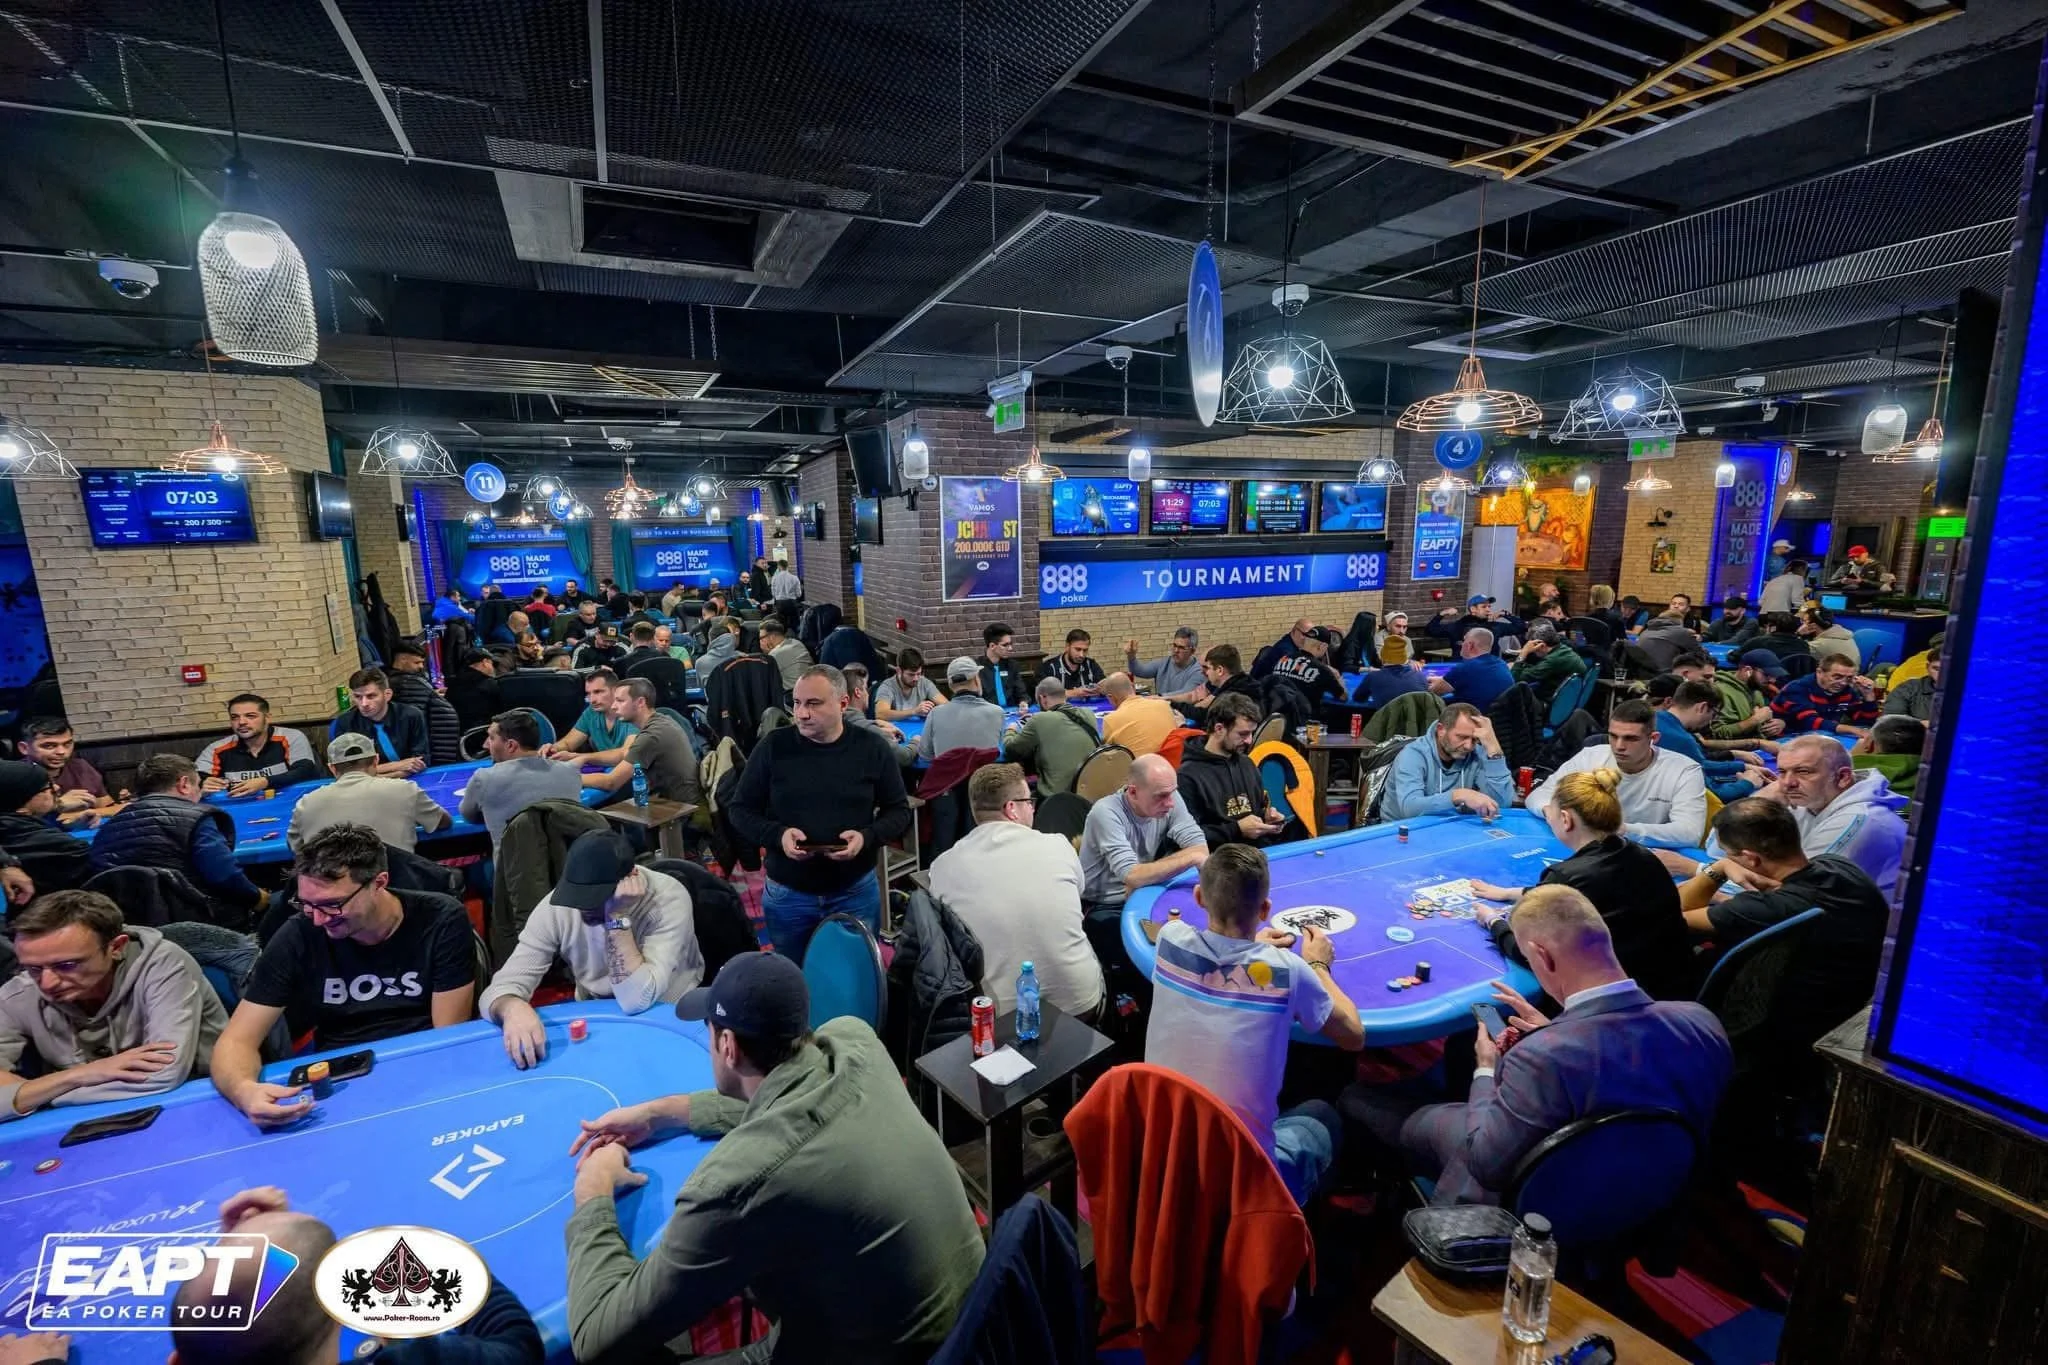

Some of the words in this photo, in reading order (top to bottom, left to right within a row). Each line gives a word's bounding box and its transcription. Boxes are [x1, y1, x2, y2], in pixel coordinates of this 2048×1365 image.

[1452, 440, 1465, 455] 4
[479, 476, 494, 489] 11
[166, 491, 219, 505] 07:03
[1735, 480, 1766, 507] 888
[968, 504, 996, 512] VAMOS
[1161, 498, 1184, 506] 11:29
[1198, 499, 1221, 508] 07:03
[1730, 522, 1762, 537] MADE
[996, 541, 1010, 552] GTD
[1421, 539, 1453, 551] EAPT
[1730, 537, 1745, 550] TO
[490, 556, 520, 571] 888
[656, 551, 682, 566] 888
[1727, 551, 1757, 565] PLAY
[1347, 554, 1380, 579] 888
[1042, 563, 1088, 594] 888
[1142, 563, 1305, 589] TOURNAMENT
[1358, 579, 1379, 588] poker
[1060, 594, 1089, 605] poker
[431, 1114, 525, 1146] EAPOKER
